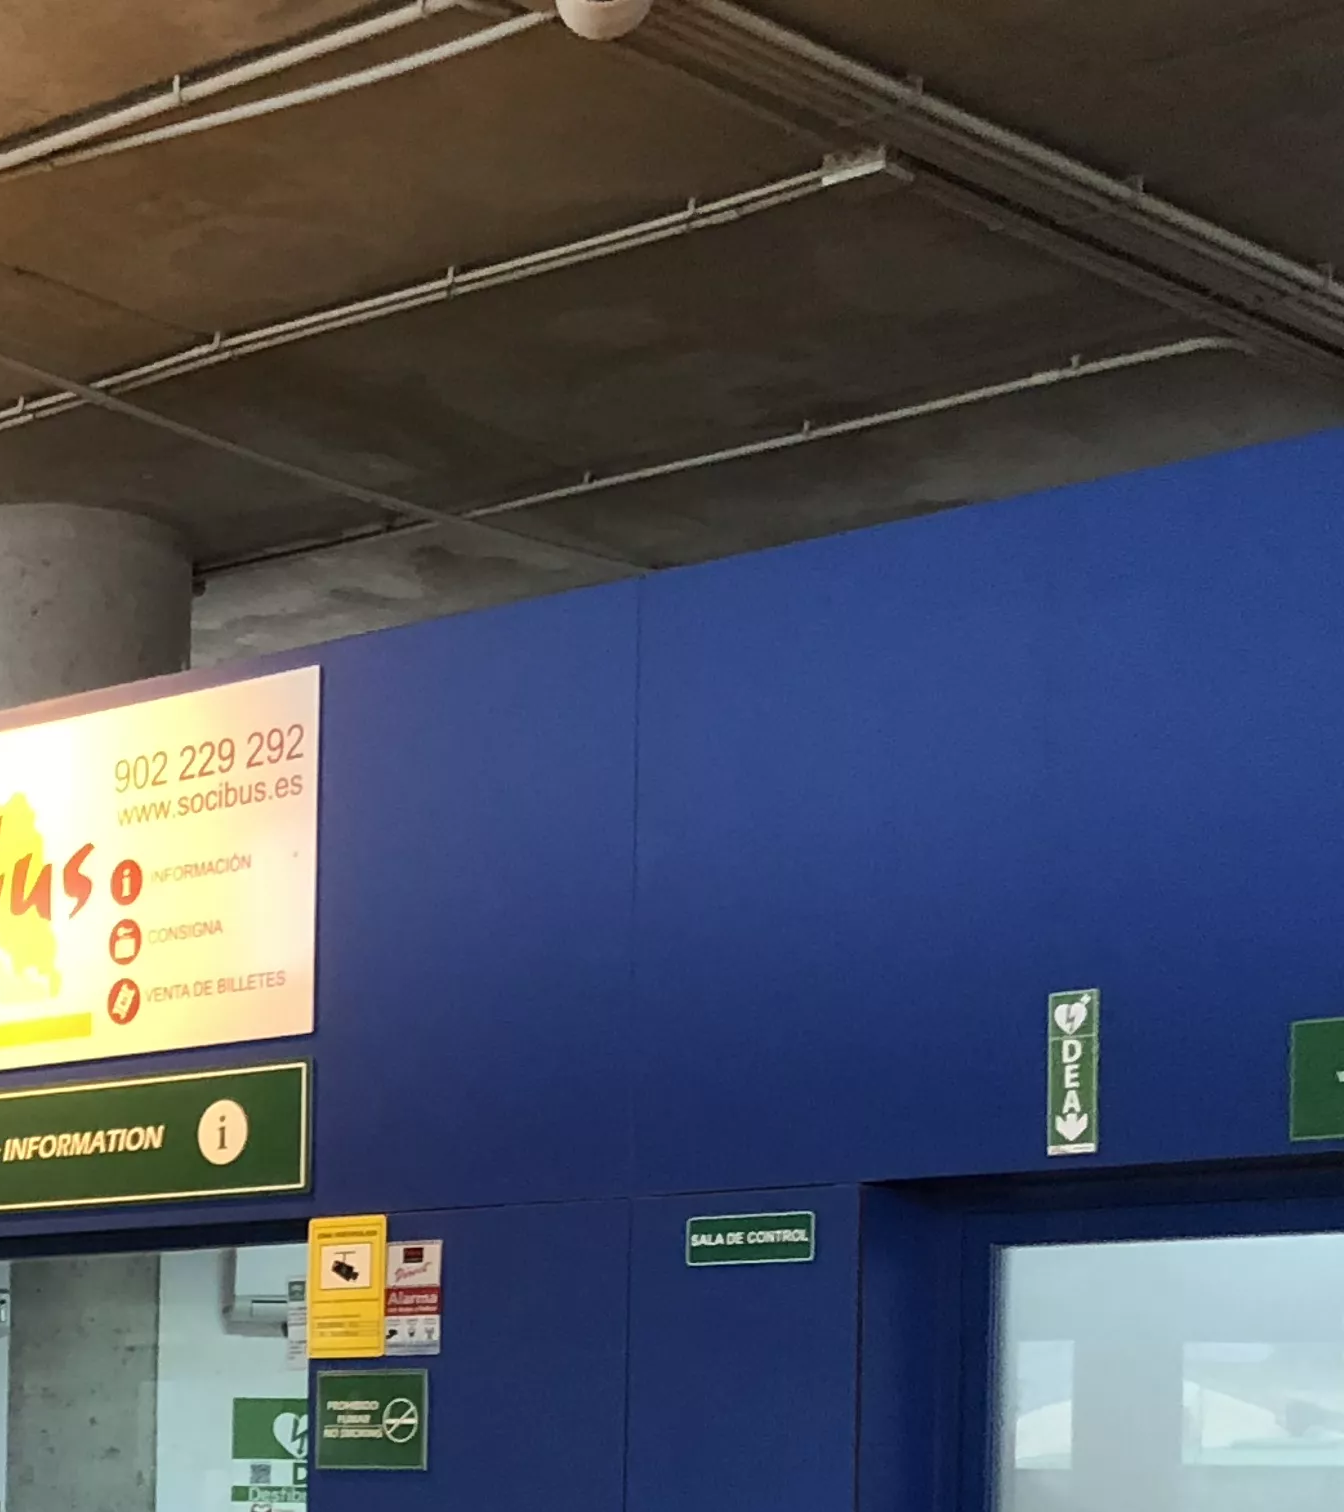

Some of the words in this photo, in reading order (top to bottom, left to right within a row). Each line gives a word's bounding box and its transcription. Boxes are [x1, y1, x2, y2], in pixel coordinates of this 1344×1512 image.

[115, 751, 168, 793] 902
[179, 738, 236, 782] 229
[246, 724, 304, 769] 292
[118, 774, 303, 826] www.socibus.es
[150, 853, 252, 883] INFORMACIÓN
[148, 920, 223, 944] CONSIGNA
[145, 983, 190, 1002] VENTA
[193, 981, 212, 997] DE
[217, 970, 286, 994] BILLETES
[1062, 1039, 1083, 1114] DEA
[3, 1125, 165, 1163] INFORMATION
[691, 1233, 725, 1247] SALA
[726, 1231, 745, 1245] DE
[747, 1228, 809, 1244] CONTROL
